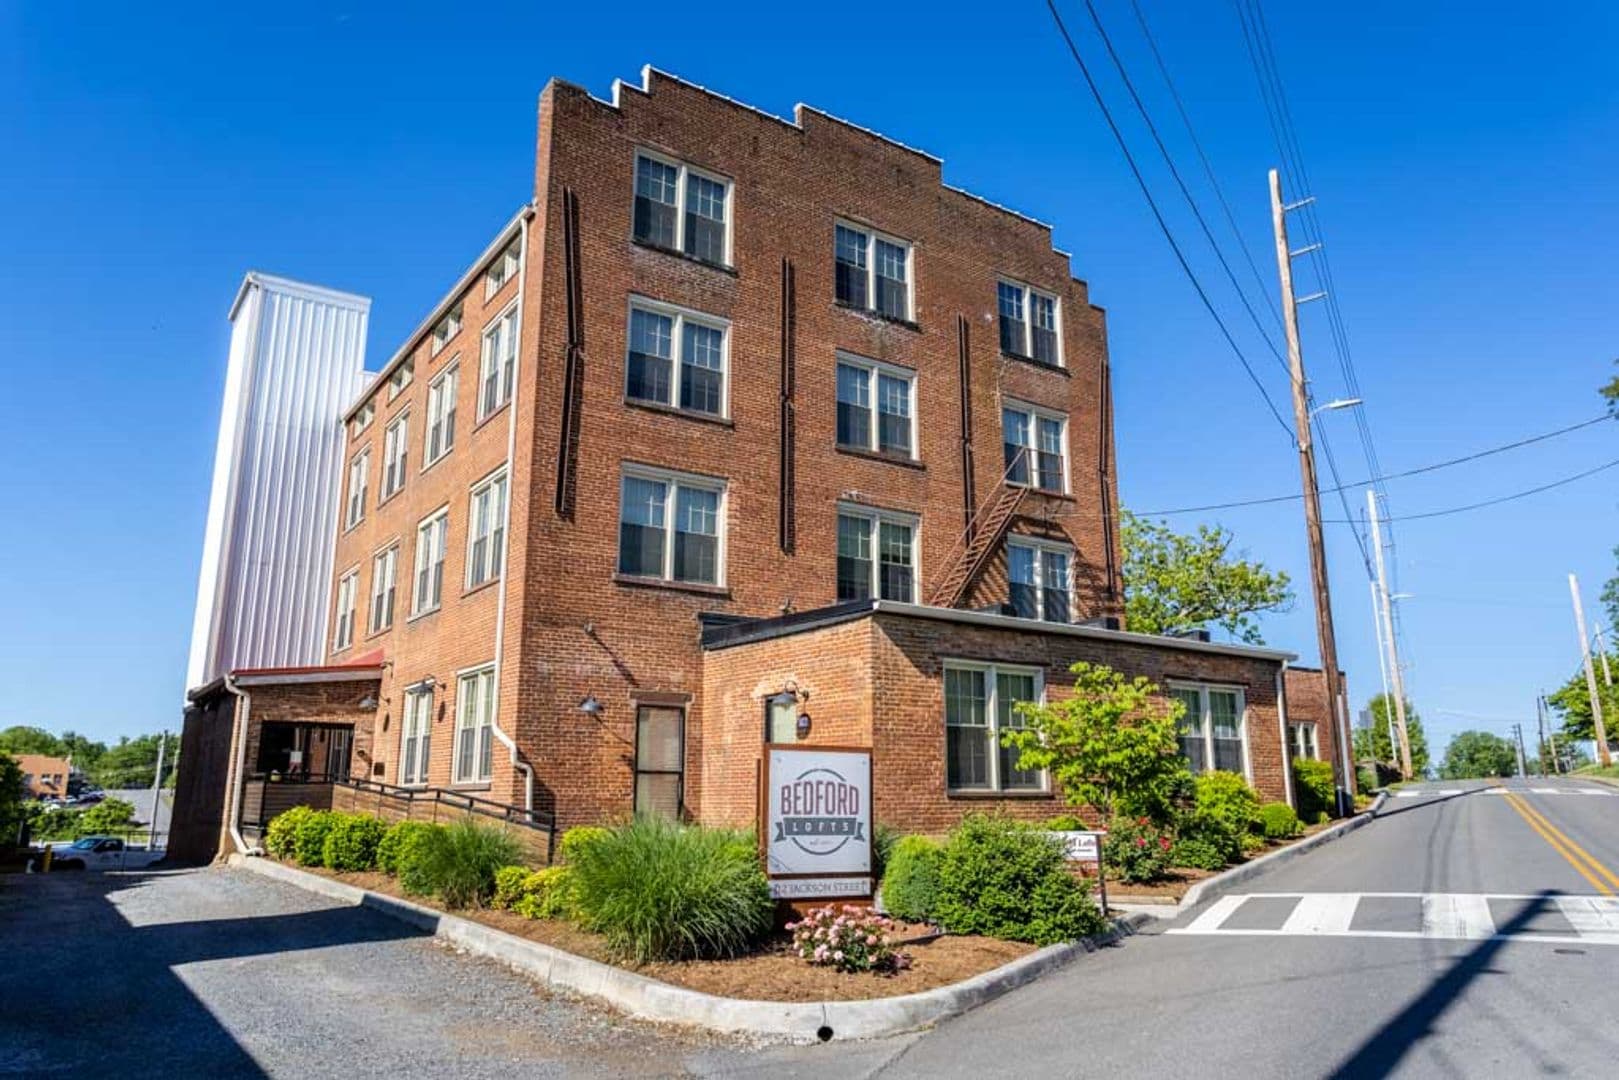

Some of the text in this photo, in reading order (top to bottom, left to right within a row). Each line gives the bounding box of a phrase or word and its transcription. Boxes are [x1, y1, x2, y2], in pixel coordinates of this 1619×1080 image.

[781, 781, 859, 815] BEDFORD
[792, 821, 849, 832] LOFTS
[789, 882, 832, 894] JACKSON
